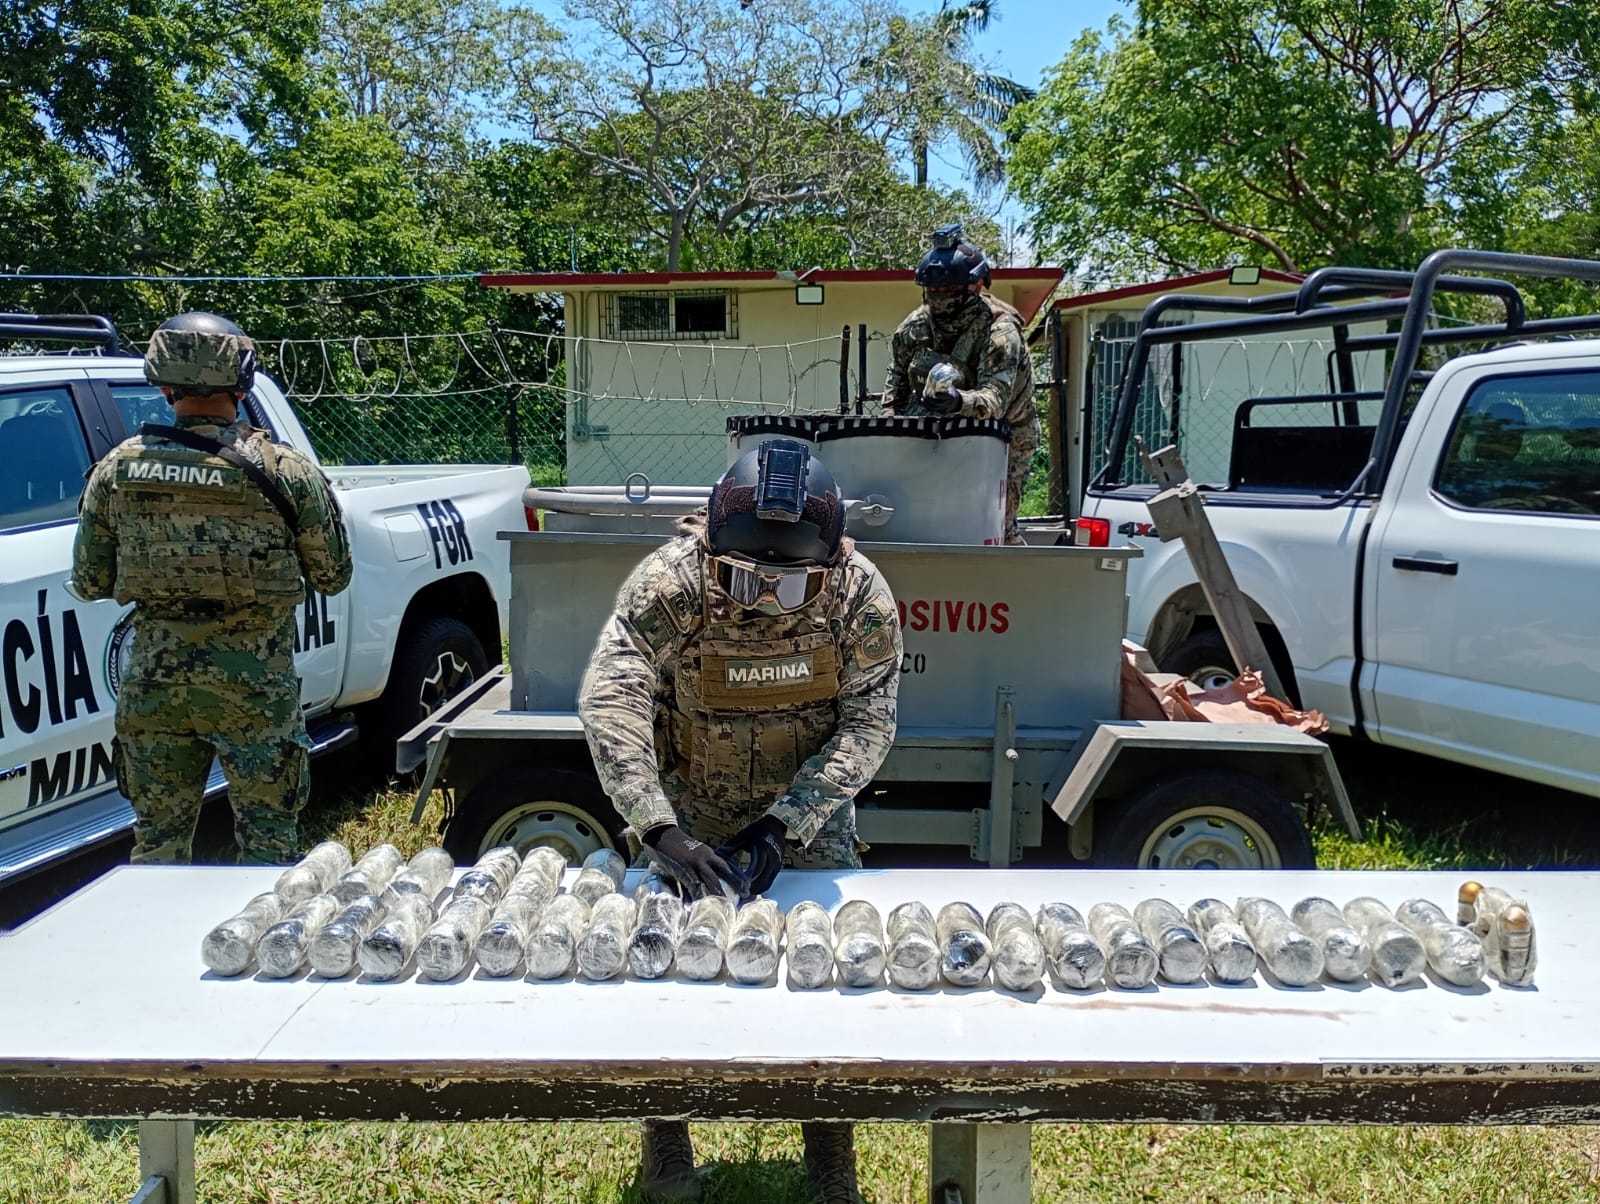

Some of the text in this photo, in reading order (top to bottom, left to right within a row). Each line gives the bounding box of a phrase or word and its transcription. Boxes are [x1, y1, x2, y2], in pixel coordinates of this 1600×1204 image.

[127, 462, 224, 487] MARINA
[416, 499, 474, 570] FGR
[0, 588, 100, 738] CÍA
[728, 662, 810, 682] MARINA
